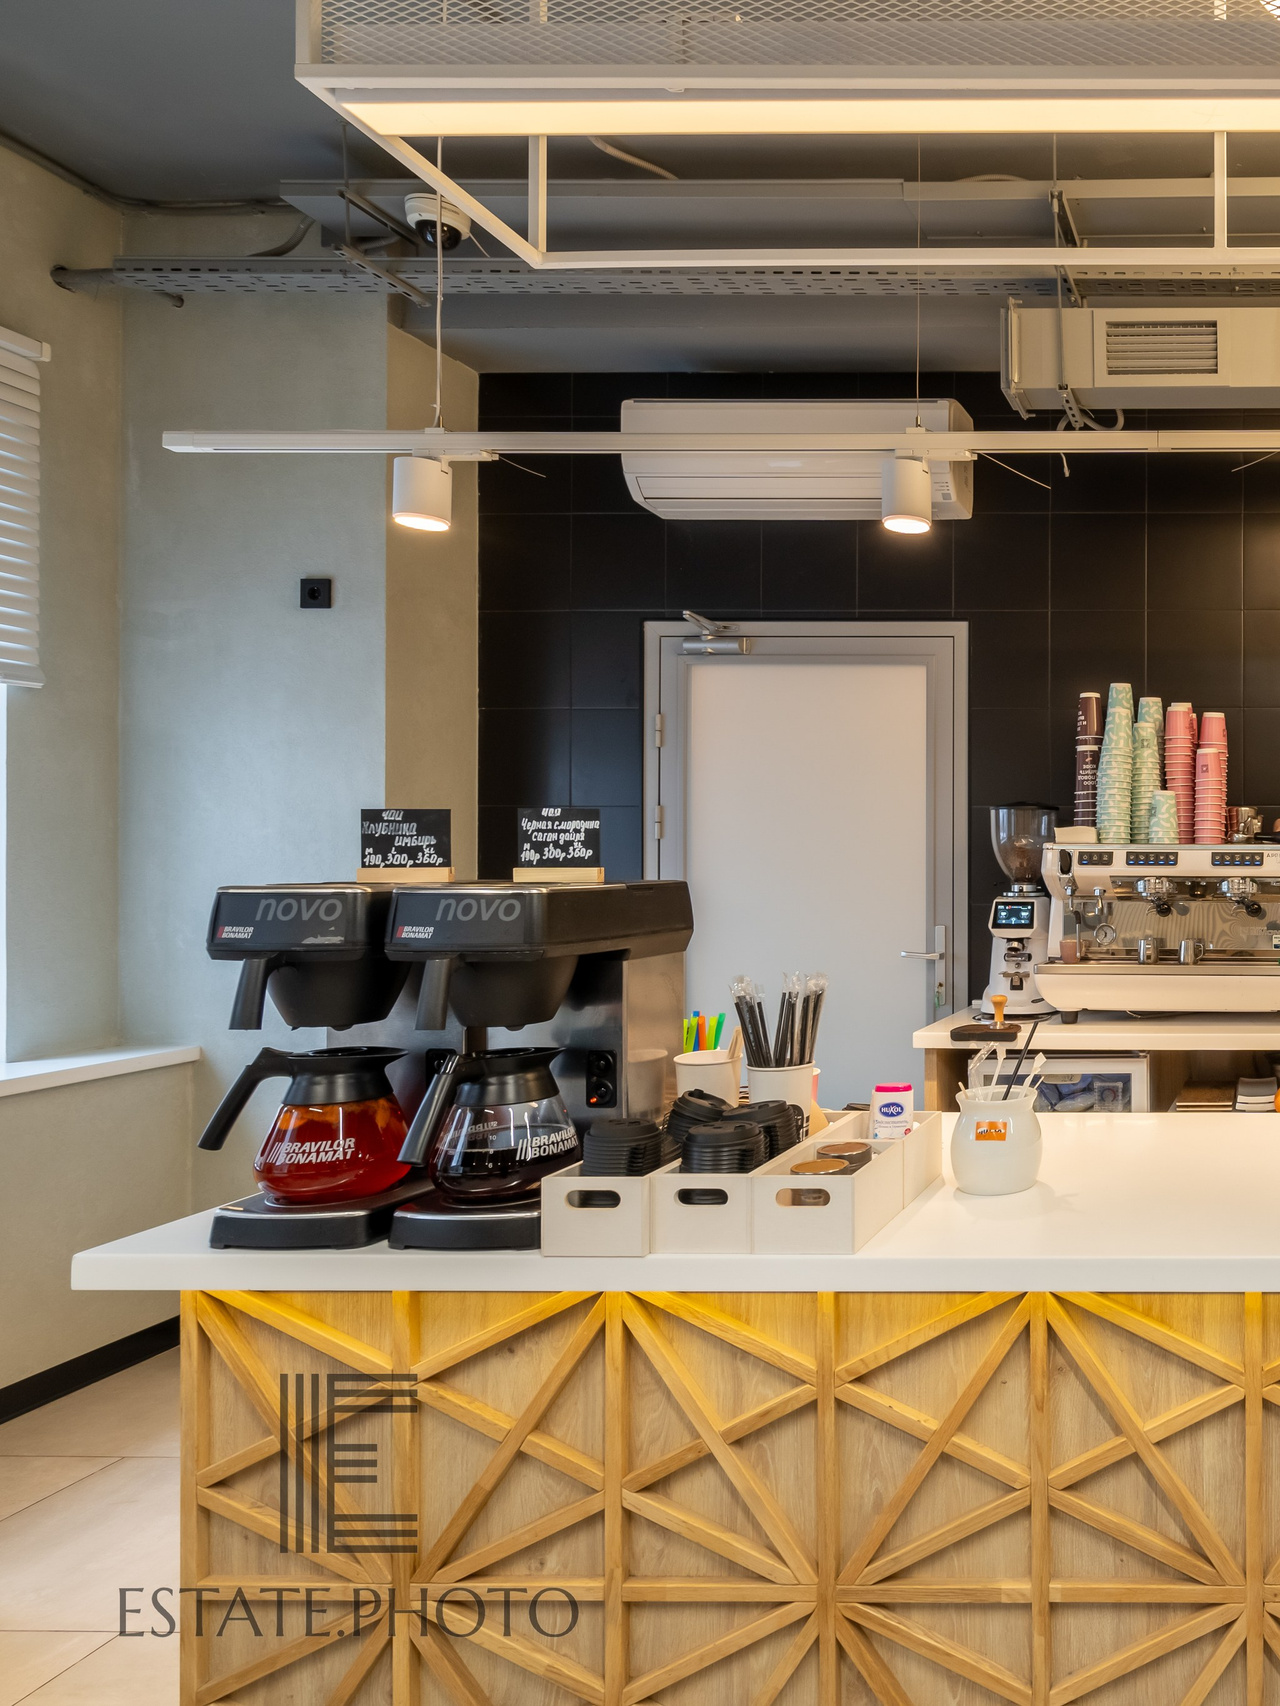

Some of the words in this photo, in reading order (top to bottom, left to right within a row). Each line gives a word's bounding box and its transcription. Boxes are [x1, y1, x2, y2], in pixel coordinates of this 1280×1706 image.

[255, 898, 343, 921] novo
[435, 898, 521, 922] novo
[283, 1138, 355, 1154] BRAVILOR
[280, 1149, 355, 1164] BONAMAT
